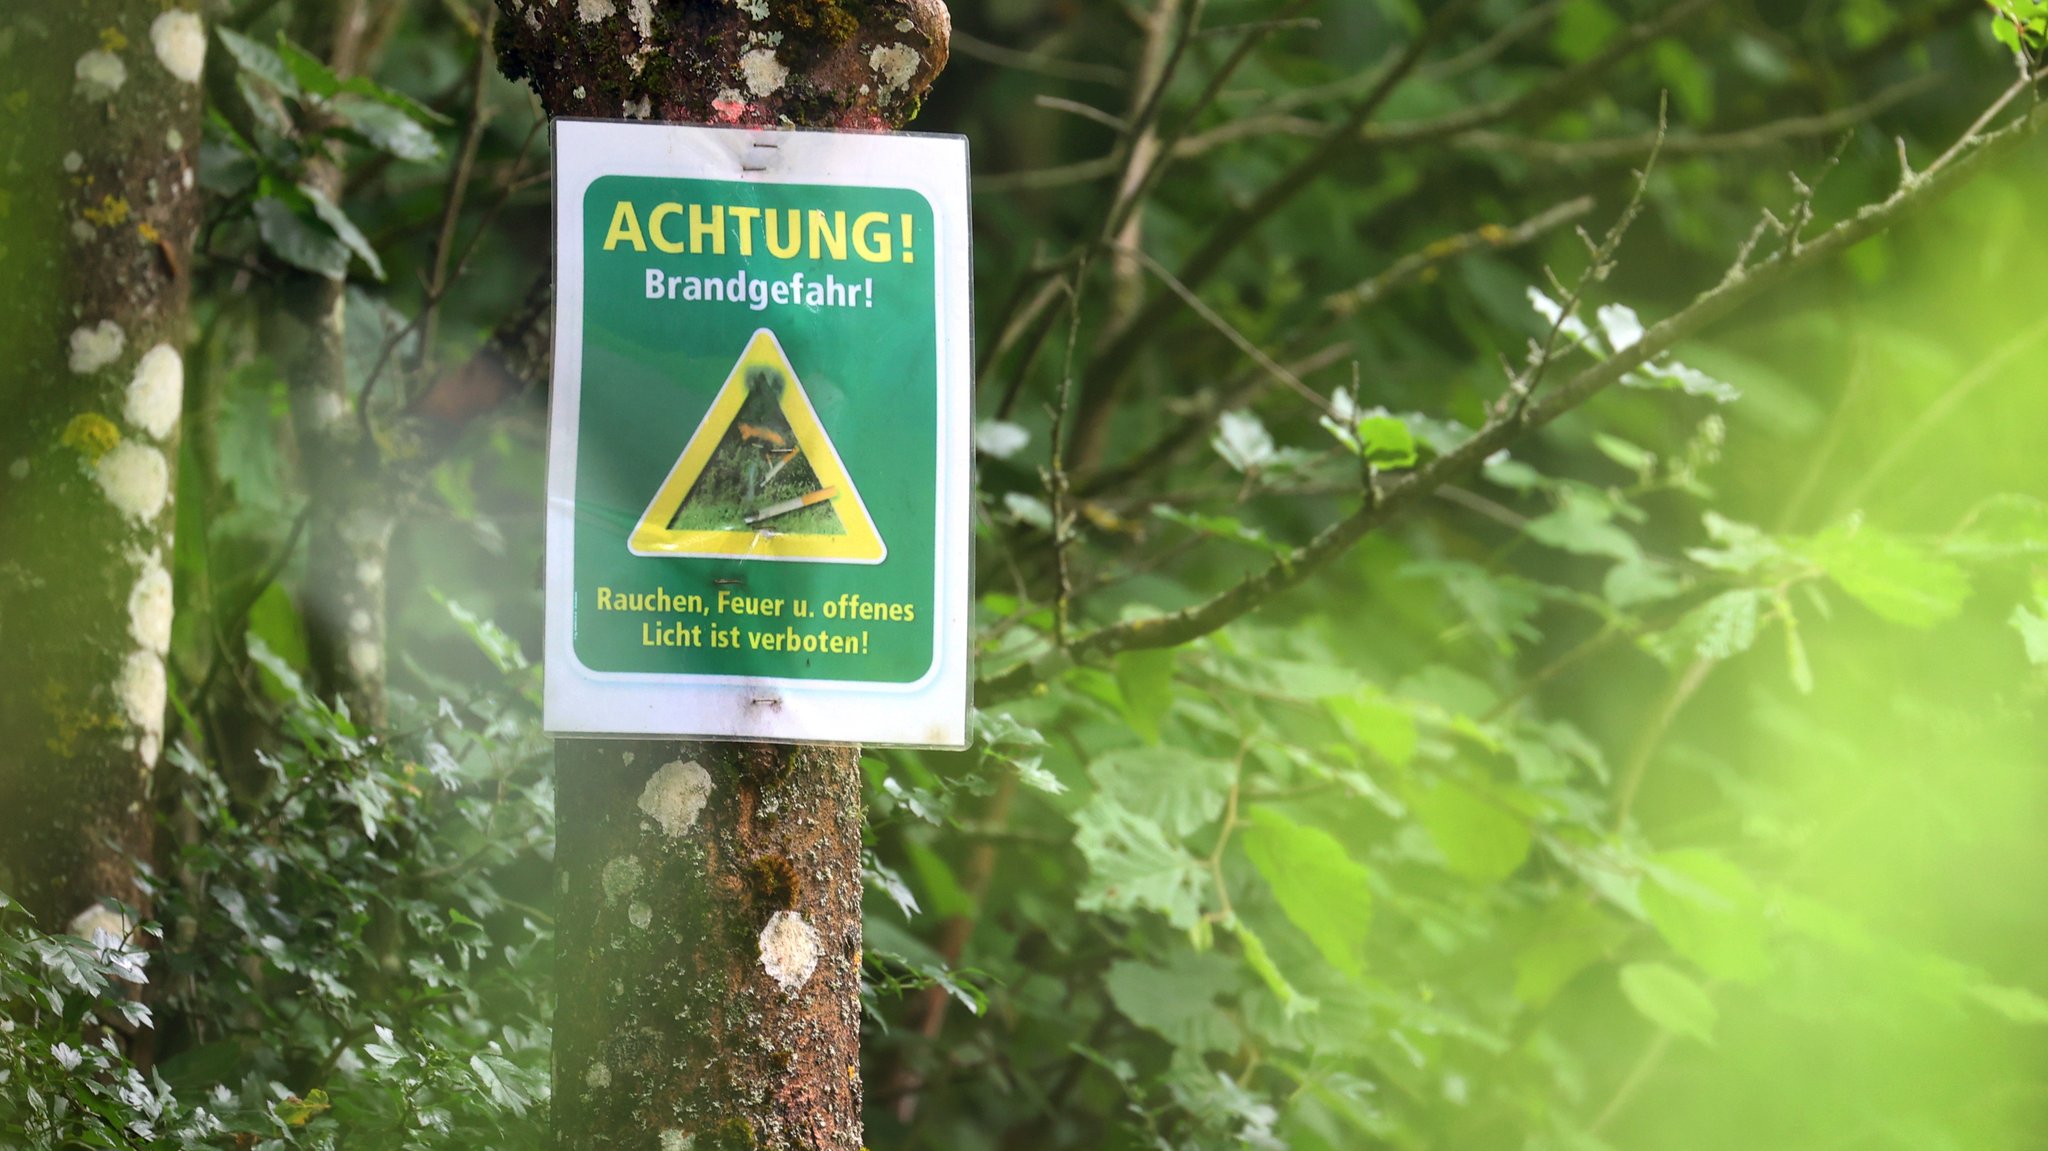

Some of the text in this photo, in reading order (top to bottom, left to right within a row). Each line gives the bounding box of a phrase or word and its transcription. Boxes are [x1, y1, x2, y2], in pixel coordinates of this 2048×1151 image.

[603, 201, 914, 263] ACHTUNG!
[645, 268, 873, 311] Brandgefahr!
[597, 586, 709, 616] Rauchen,
[718, 590, 784, 617] Feuer
[793, 599, 815, 618] u.
[822, 593, 915, 621] offenes
[642, 622, 869, 654] Licht ist verboten!
